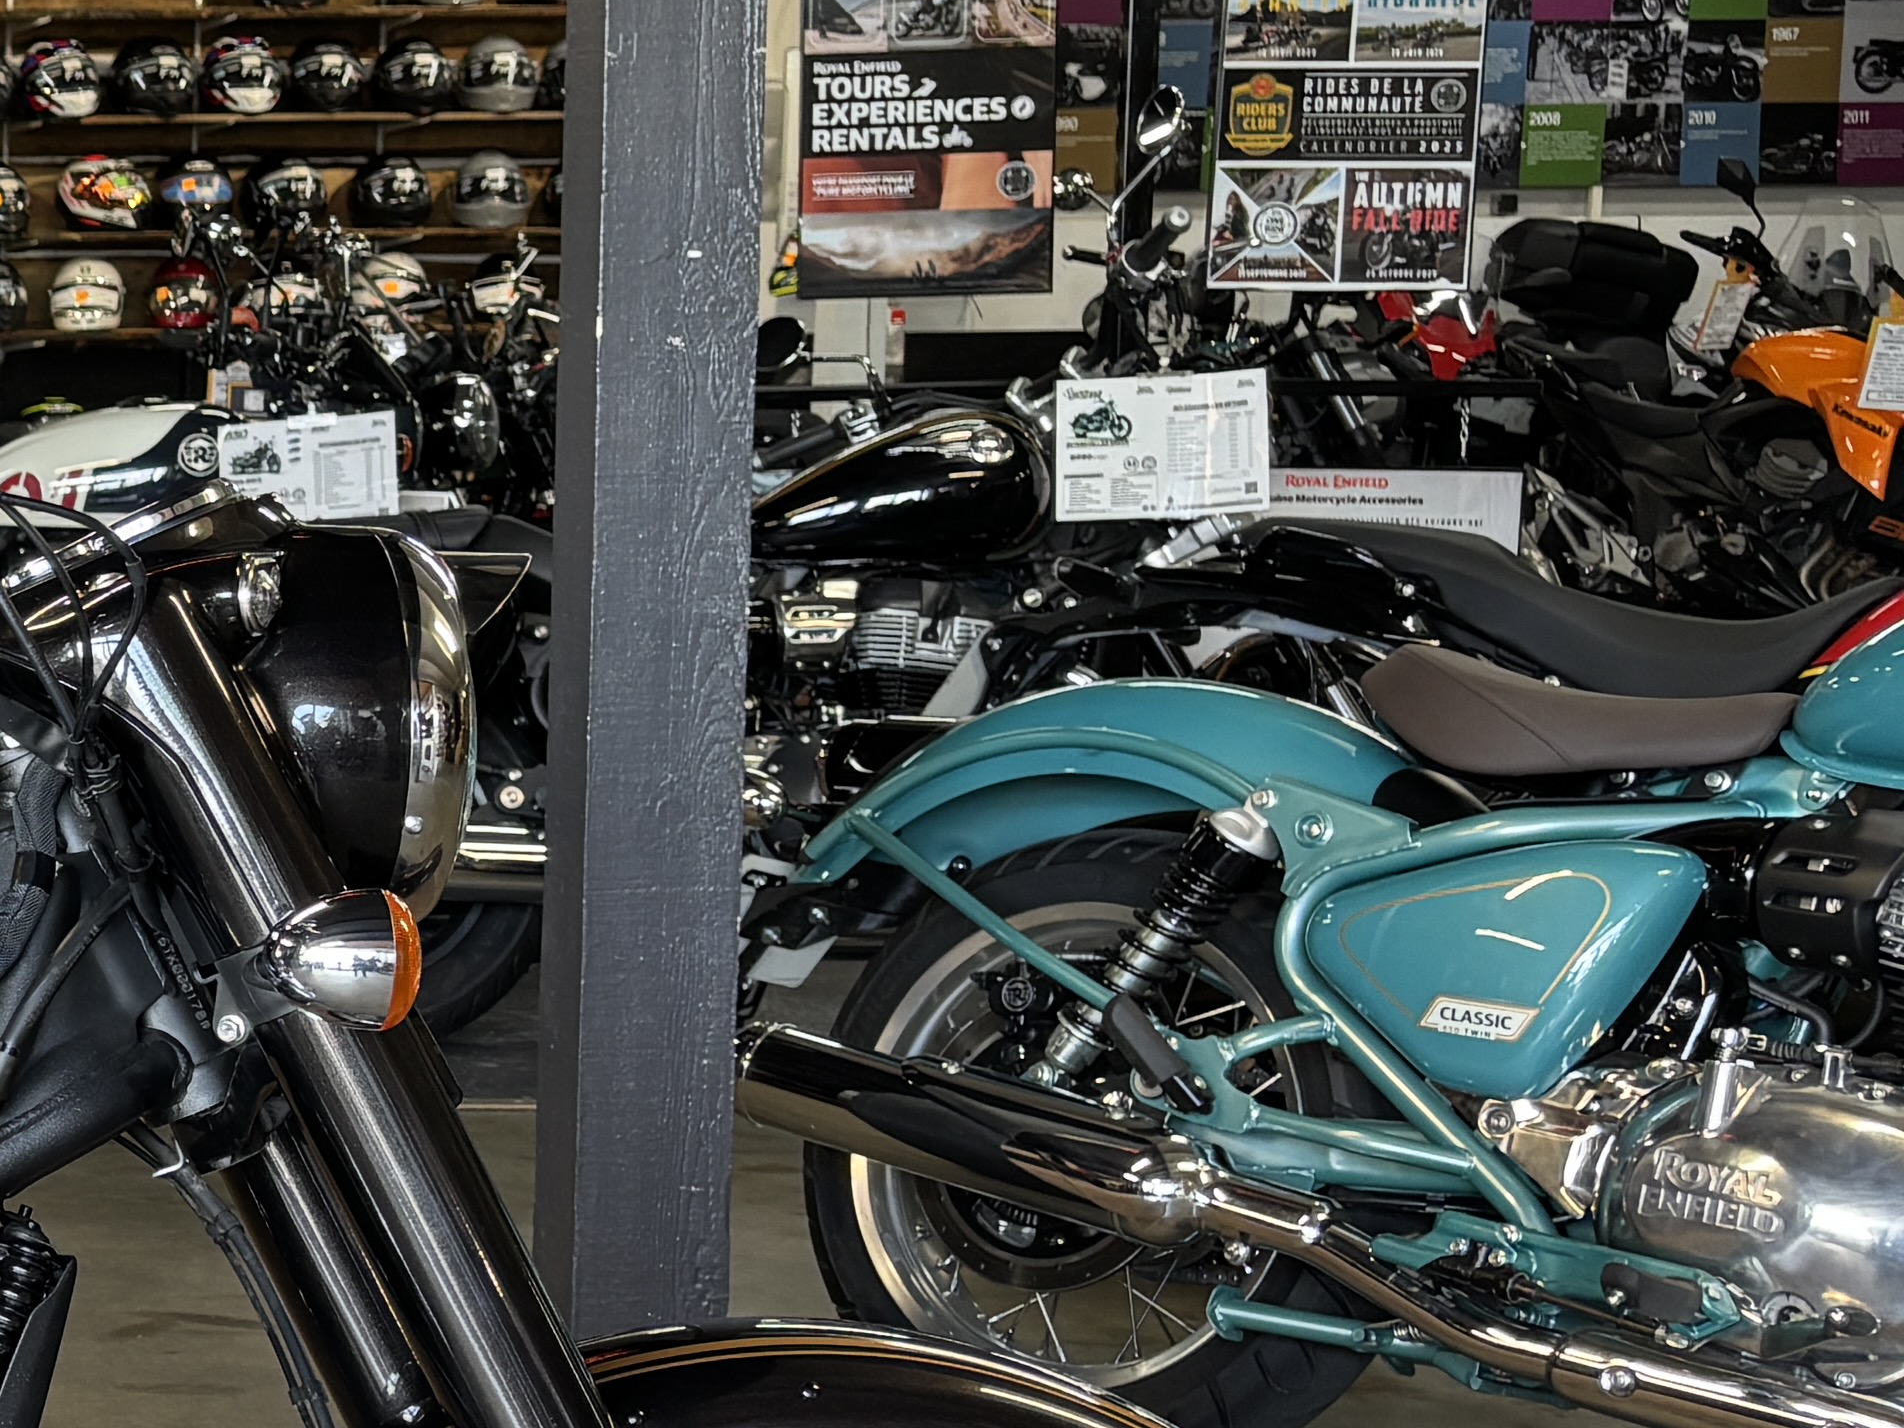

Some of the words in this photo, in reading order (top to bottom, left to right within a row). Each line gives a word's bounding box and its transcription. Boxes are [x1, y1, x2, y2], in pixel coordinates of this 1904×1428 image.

[813, 61, 850, 75] ROYAL
[812, 74, 911, 100] TOURS
[1303, 77, 1360, 95] RIDES
[1370, 77, 1392, 95] DE
[1403, 77, 1424, 95] LA
[811, 97, 1008, 127] EXPERIENCES
[1236, 102, 1286, 118] RIDERS
[1688, 110, 1716, 126] 2010
[1842, 109, 1870, 125] 2011
[1242, 117, 1277, 132] CLUB
[1528, 111, 1561, 127] 2008
[811, 125, 941, 153] RENTALS
[1299, 140, 1408, 154] CALENDRIER
[1419, 140, 1464, 154] 2025
[1353, 181, 1462, 209] AUTUMN
[1352, 208, 1402, 233] FALL
[1406, 208, 1460, 234] RIDE
[1285, 474, 1330, 489] ROYAL
[1333, 474, 1390, 490] ENFIELD
[1295, 494, 1357, 507] Motorcycle
[1358, 494, 1424, 506] Accessories
[1439, 1006, 1513, 1030] CLASSIC
[1464, 1027, 1491, 1038] TWIN
[1652, 1146, 1781, 1206] ROYAL
[1636, 1183, 1785, 1242] ENFIELD
